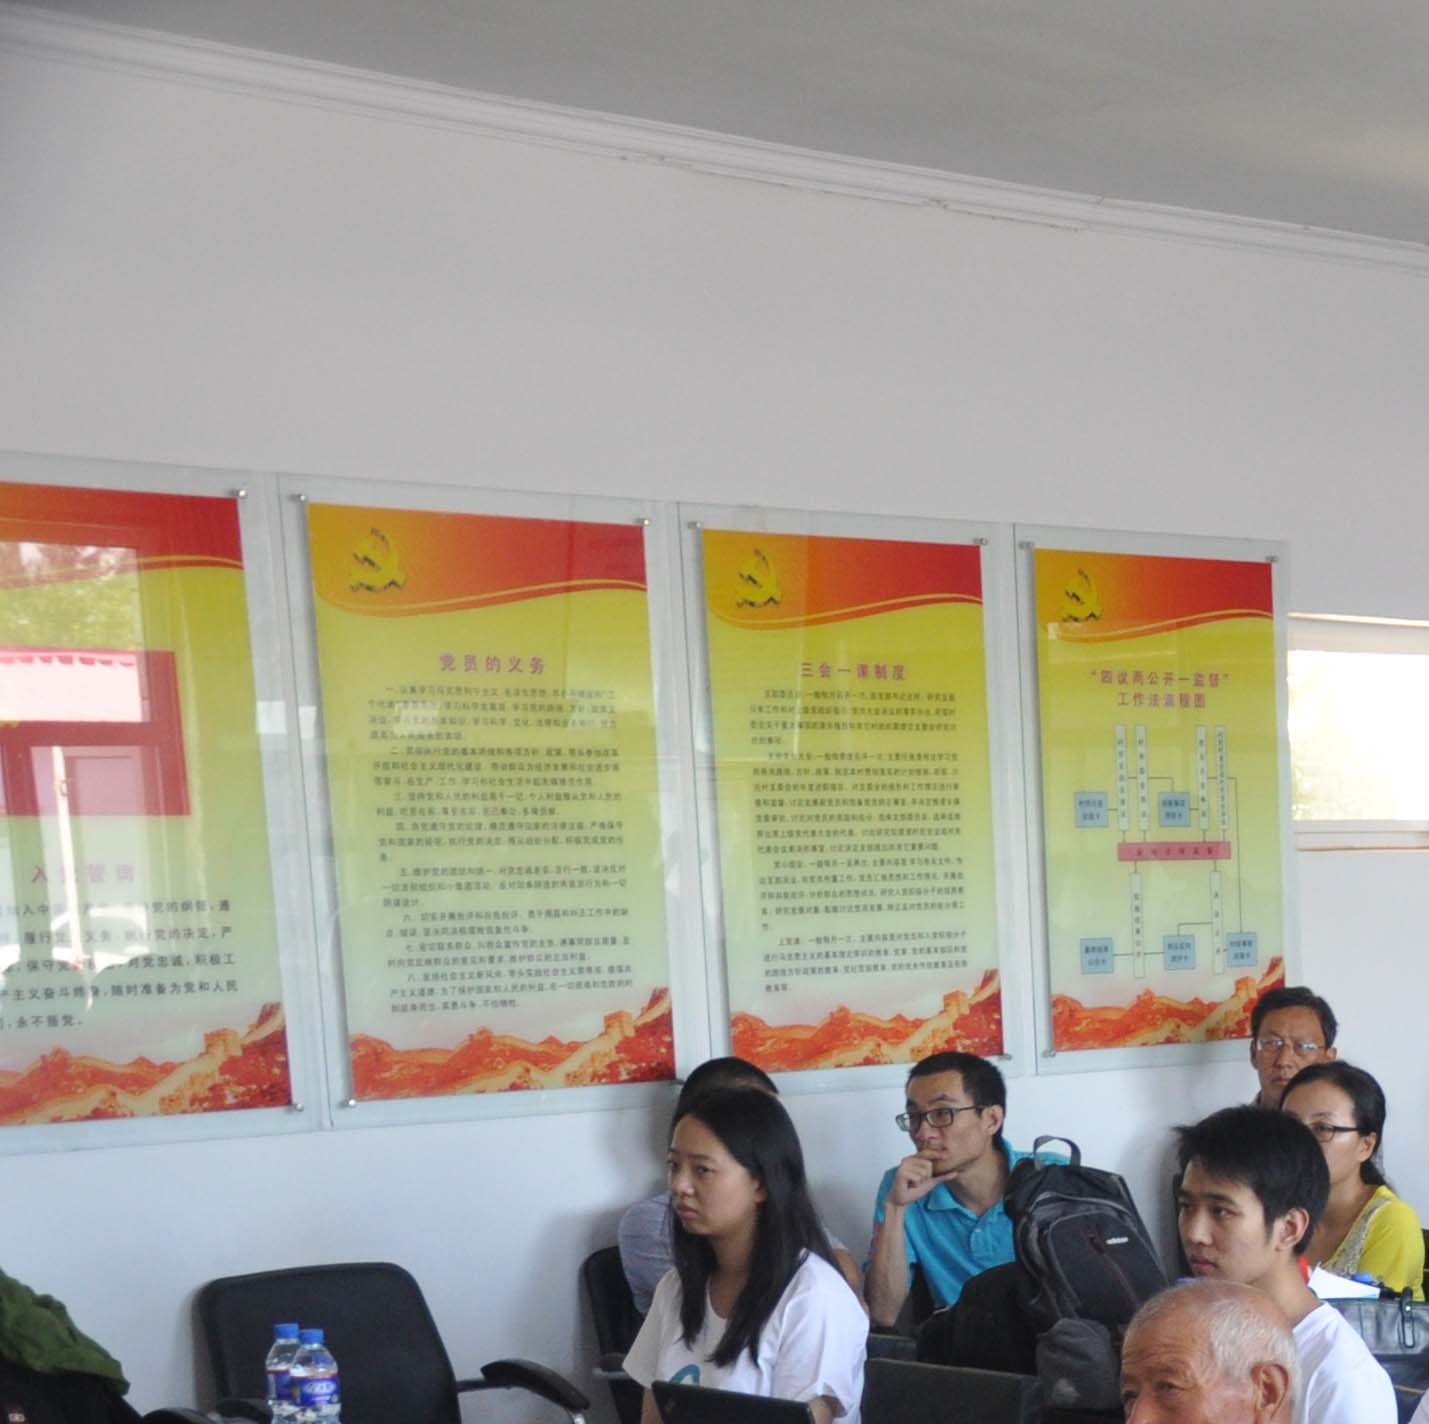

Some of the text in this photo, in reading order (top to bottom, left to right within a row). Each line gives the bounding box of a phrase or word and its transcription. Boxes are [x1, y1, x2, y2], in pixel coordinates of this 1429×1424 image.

[440, 654, 545, 674] 党员的义务
[801, 661, 906, 681] 三会一课制度
